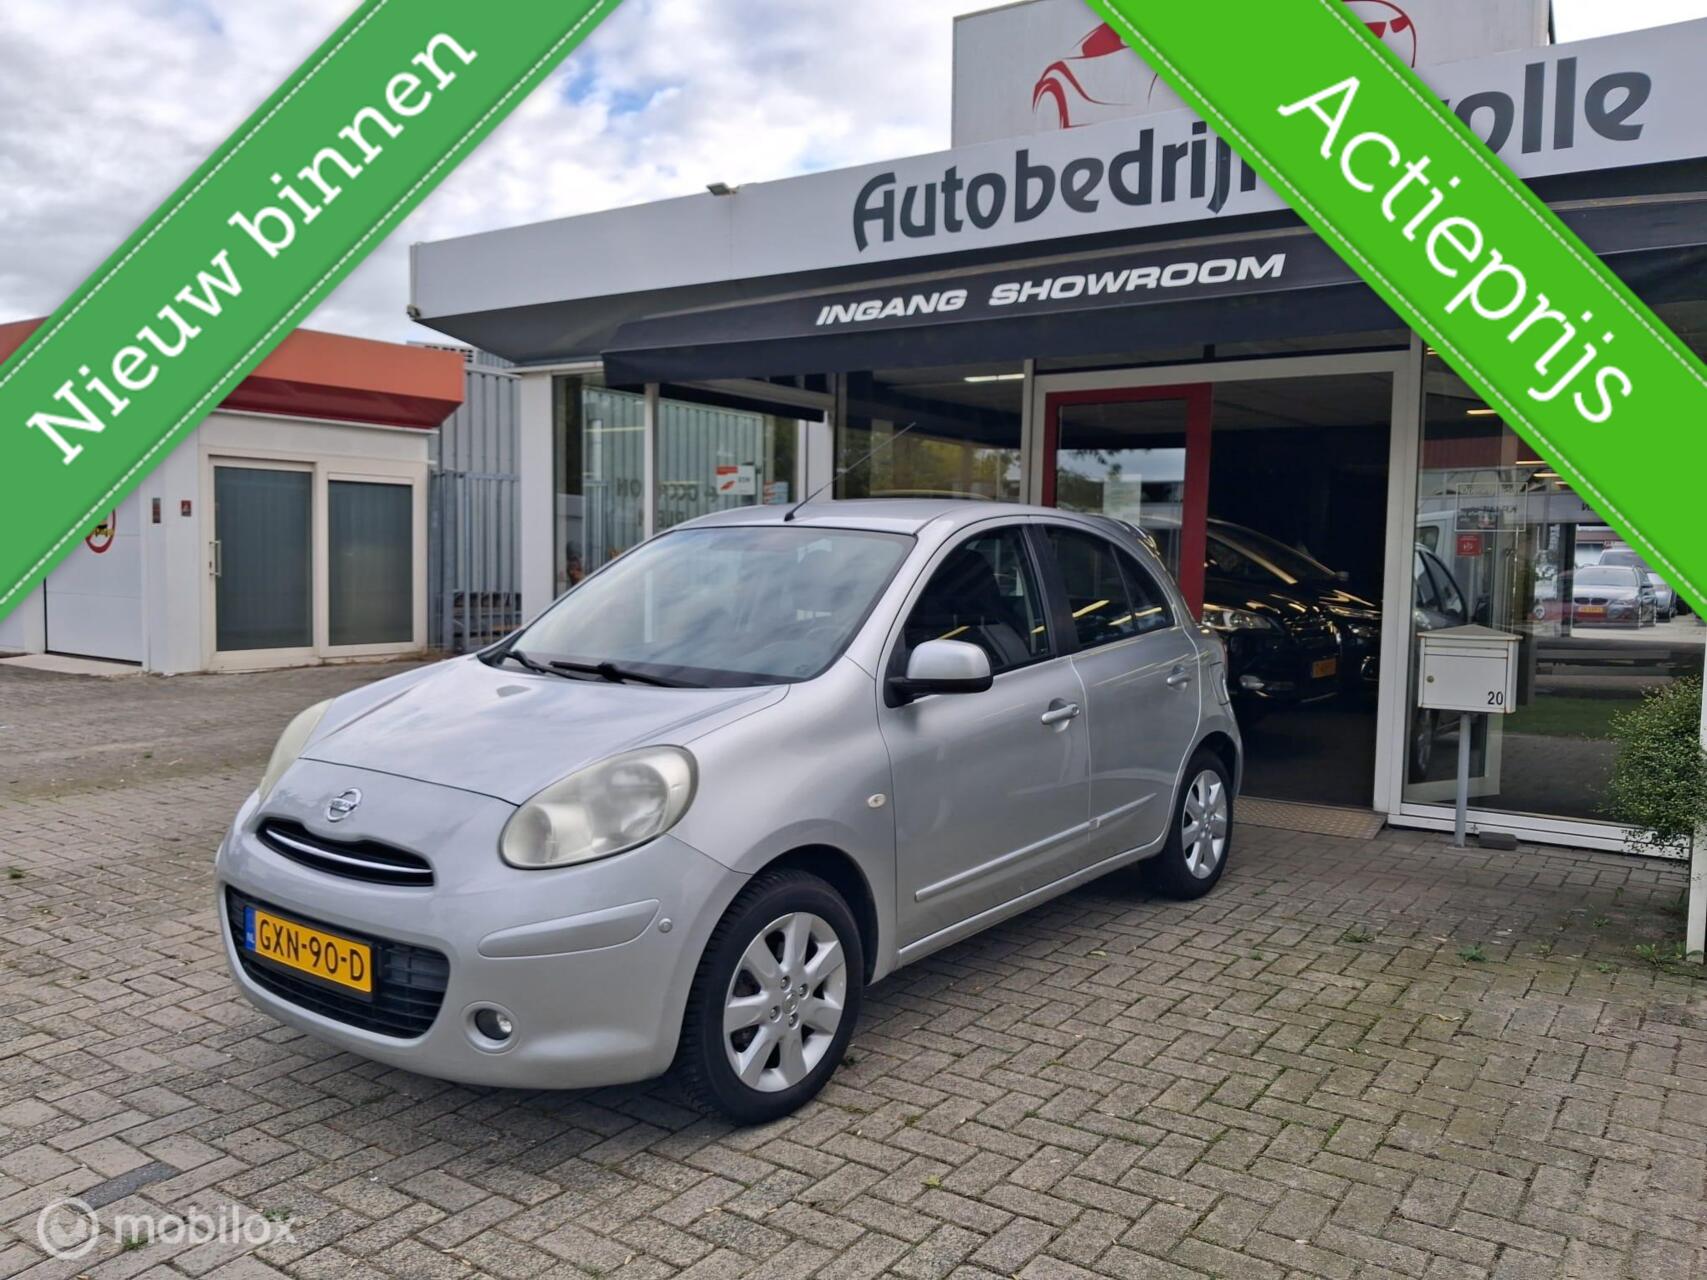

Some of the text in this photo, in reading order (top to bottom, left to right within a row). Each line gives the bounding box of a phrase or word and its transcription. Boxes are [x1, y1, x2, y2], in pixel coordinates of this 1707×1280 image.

[1438, 57, 1651, 155] olle
[815, 253, 1286, 328] INGANG SHOWROOM
[1487, 690, 1504, 706] 20
[258, 919, 366, 983] GXN-90-D
